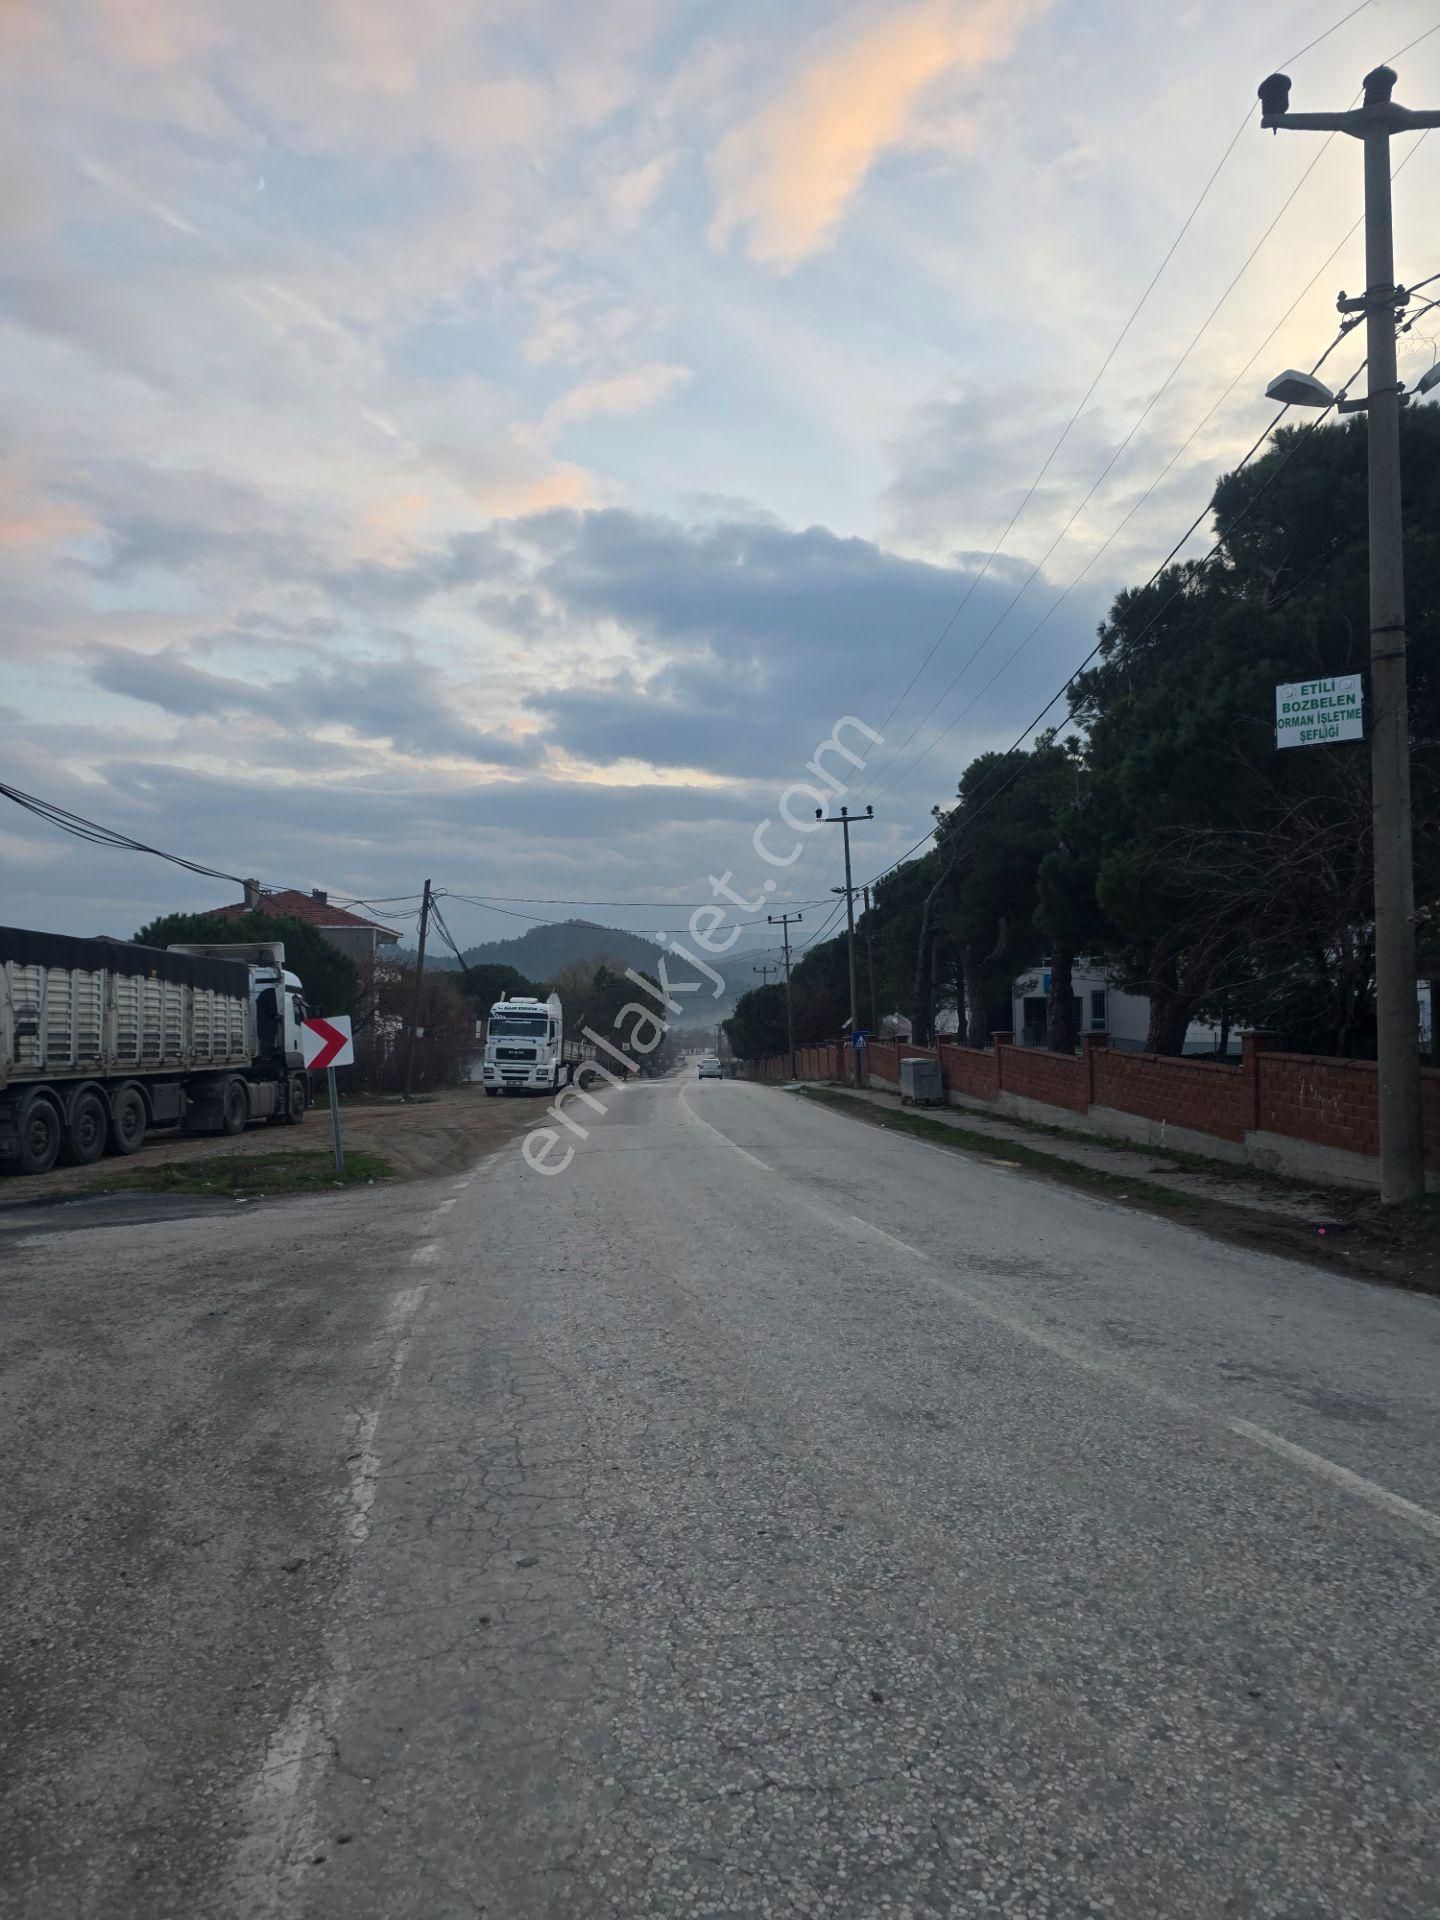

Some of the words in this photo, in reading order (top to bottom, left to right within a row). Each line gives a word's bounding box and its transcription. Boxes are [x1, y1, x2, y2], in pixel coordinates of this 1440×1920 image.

[1301, 679, 1335, 696] ETİLİ
[1282, 693, 1356, 714] BOZBELEN
[1278, 714, 1314, 729] ORMAN
[1317, 708, 1362, 724] İŞLETME
[1299, 724, 1339, 744] ŞEFLİĞİ
